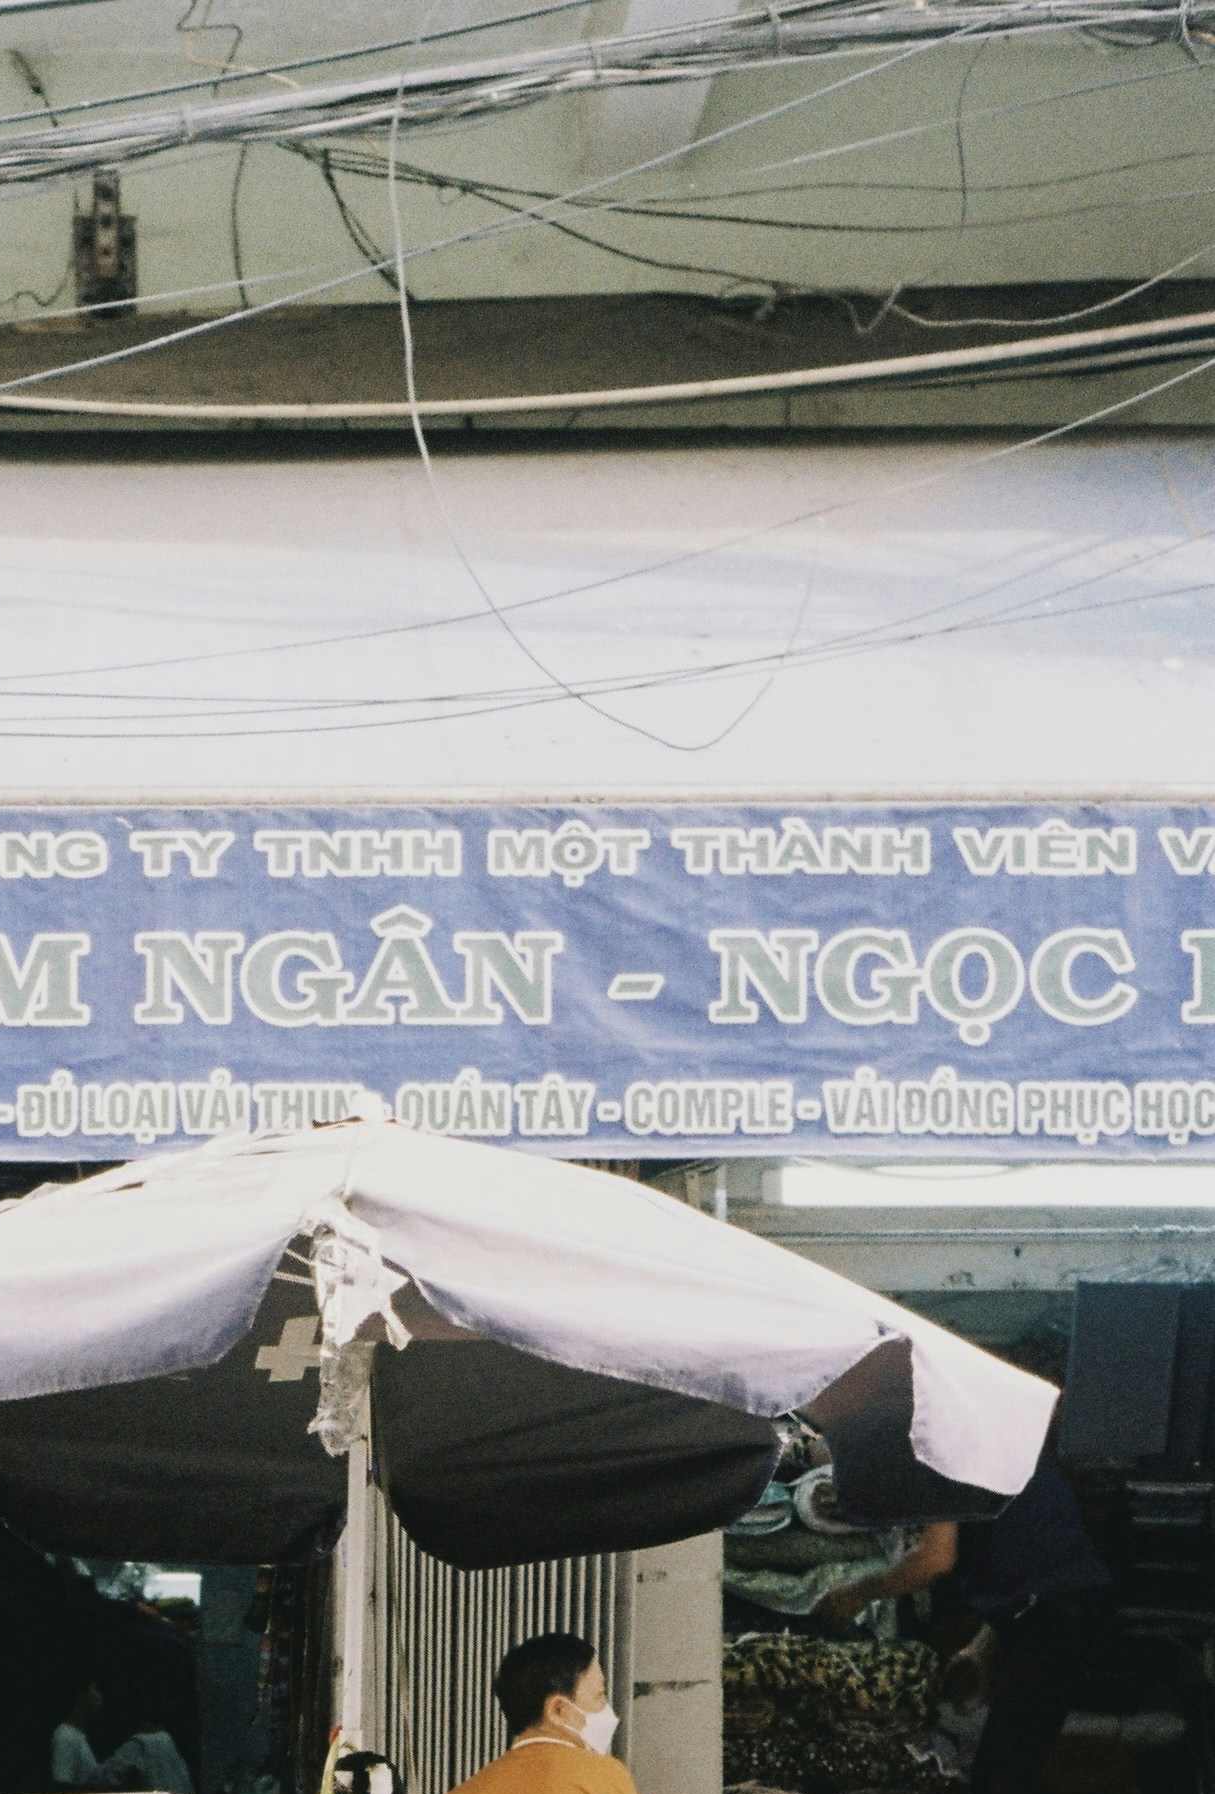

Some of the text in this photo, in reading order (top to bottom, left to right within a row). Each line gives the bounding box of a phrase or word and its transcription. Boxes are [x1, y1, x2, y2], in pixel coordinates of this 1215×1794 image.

[132, 832, 232, 875] TY
[258, 832, 459, 875] TNHH
[489, 821, 649, 885] MỘT
[673, 820, 930, 874] THÀNH
[954, 822, 1135, 873] VIÊN
[1159, 829, 1215, 874] V
[136, 906, 561, 1024] NGÂN
[610, 975, 662, 1000] -
[709, 928, 1135, 1044] NGỌC
[19, 1072, 75, 1135] ĐỦ
[84, 1084, 174, 1141] LOẠI
[180, 1069, 248, 1133] VẢI
[398, 1069, 510, 1134] QUẦN
[516, 1075, 594, 1133] TÂY
[627, 1083, 791, 1133] COMPLE
[900, 1068, 1013, 1133] ĐỒNG
[1019, 1083, 1130, 1142] PHỤC
